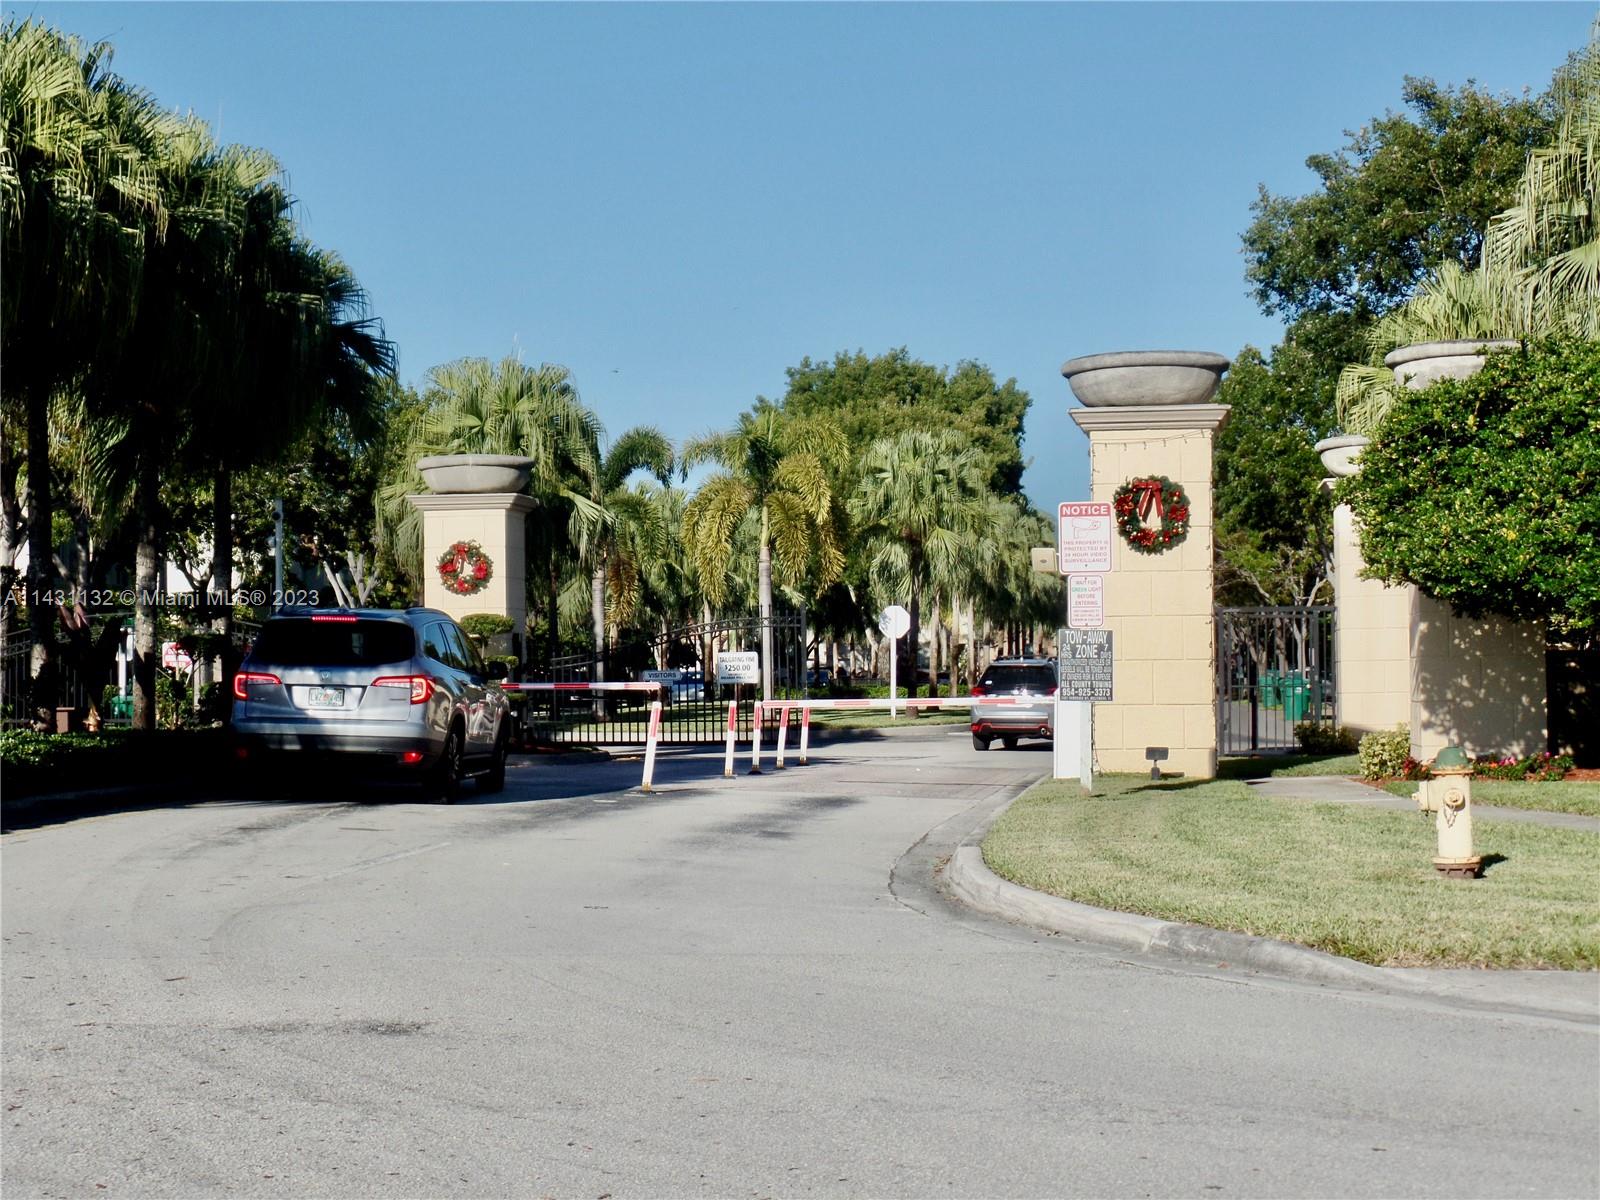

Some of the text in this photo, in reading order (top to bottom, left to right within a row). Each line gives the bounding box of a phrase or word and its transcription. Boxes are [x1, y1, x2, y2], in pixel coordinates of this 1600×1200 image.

[1062, 506, 1108, 515] NOTICE
[1065, 630, 1107, 644] TOW-AWAY
[1076, 645, 1098, 658] ZONE
